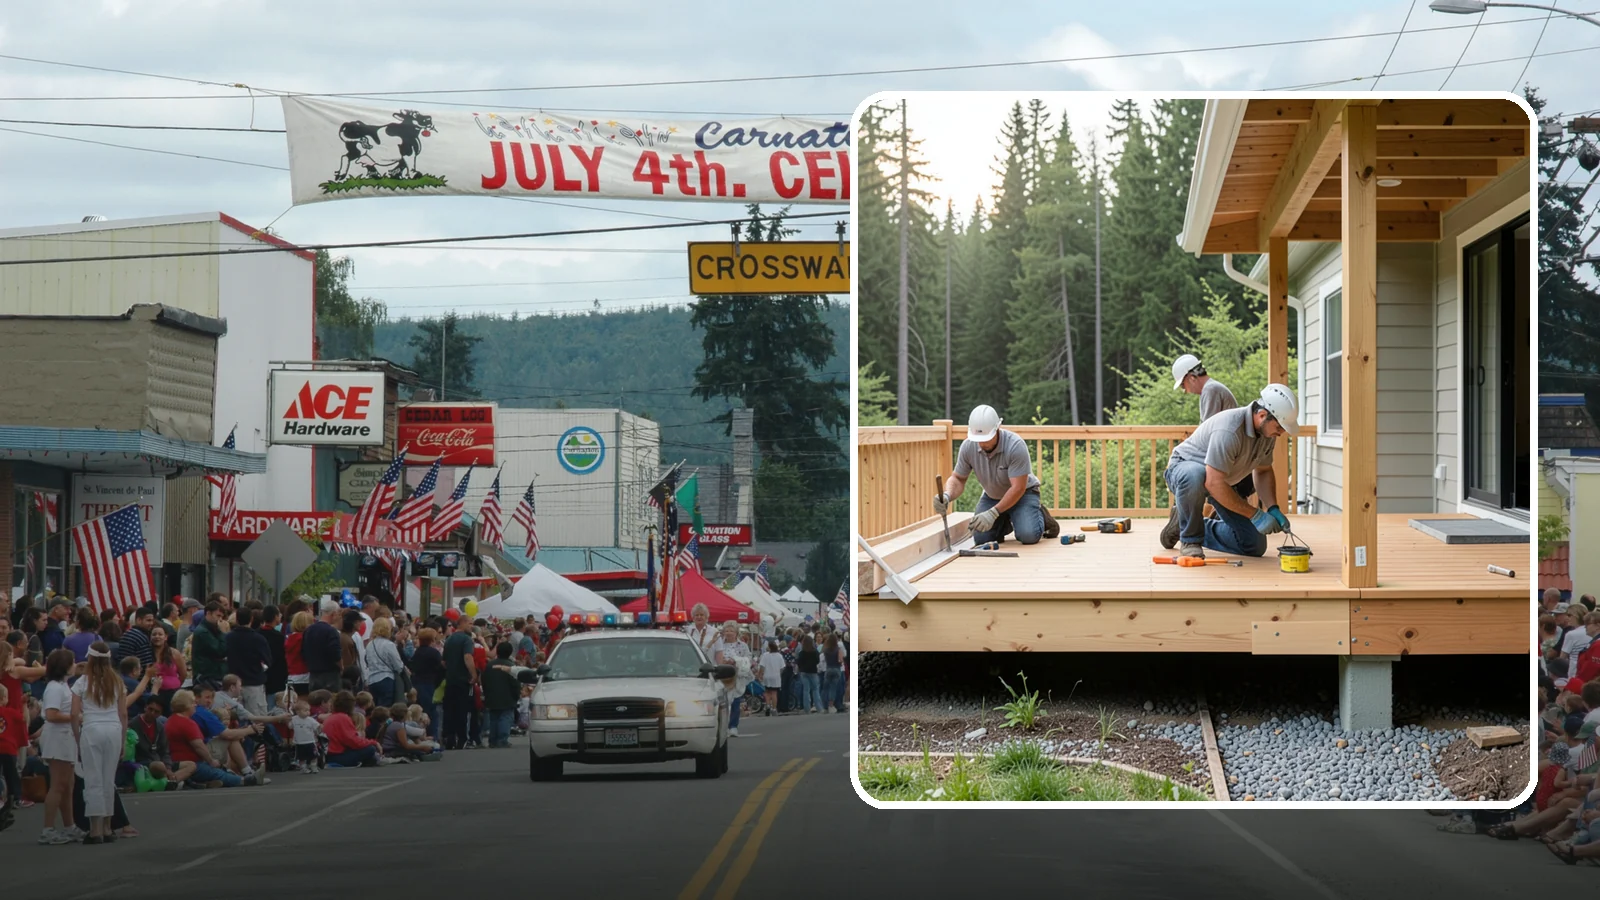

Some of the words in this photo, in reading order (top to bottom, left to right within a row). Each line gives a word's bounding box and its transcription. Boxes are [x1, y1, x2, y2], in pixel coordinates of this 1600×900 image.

[481, 141, 605, 192] JULY
[632, 150, 746, 198] 4th.
[696, 254, 850, 280] CROSSWA
[282, 380, 374, 420] ACE
[405, 409, 452, 422] CEDAR
[283, 421, 371, 437] Hardware
[416, 428, 477, 447] Coca-Cola
[353, 467, 386, 480] Simpl
[96, 485, 124, 494] Vincent
[126, 485, 136, 494] de
[137, 485, 155, 495] Paul
[688, 527, 742, 535] CRNATION
[699, 535, 730, 543] GLASS
